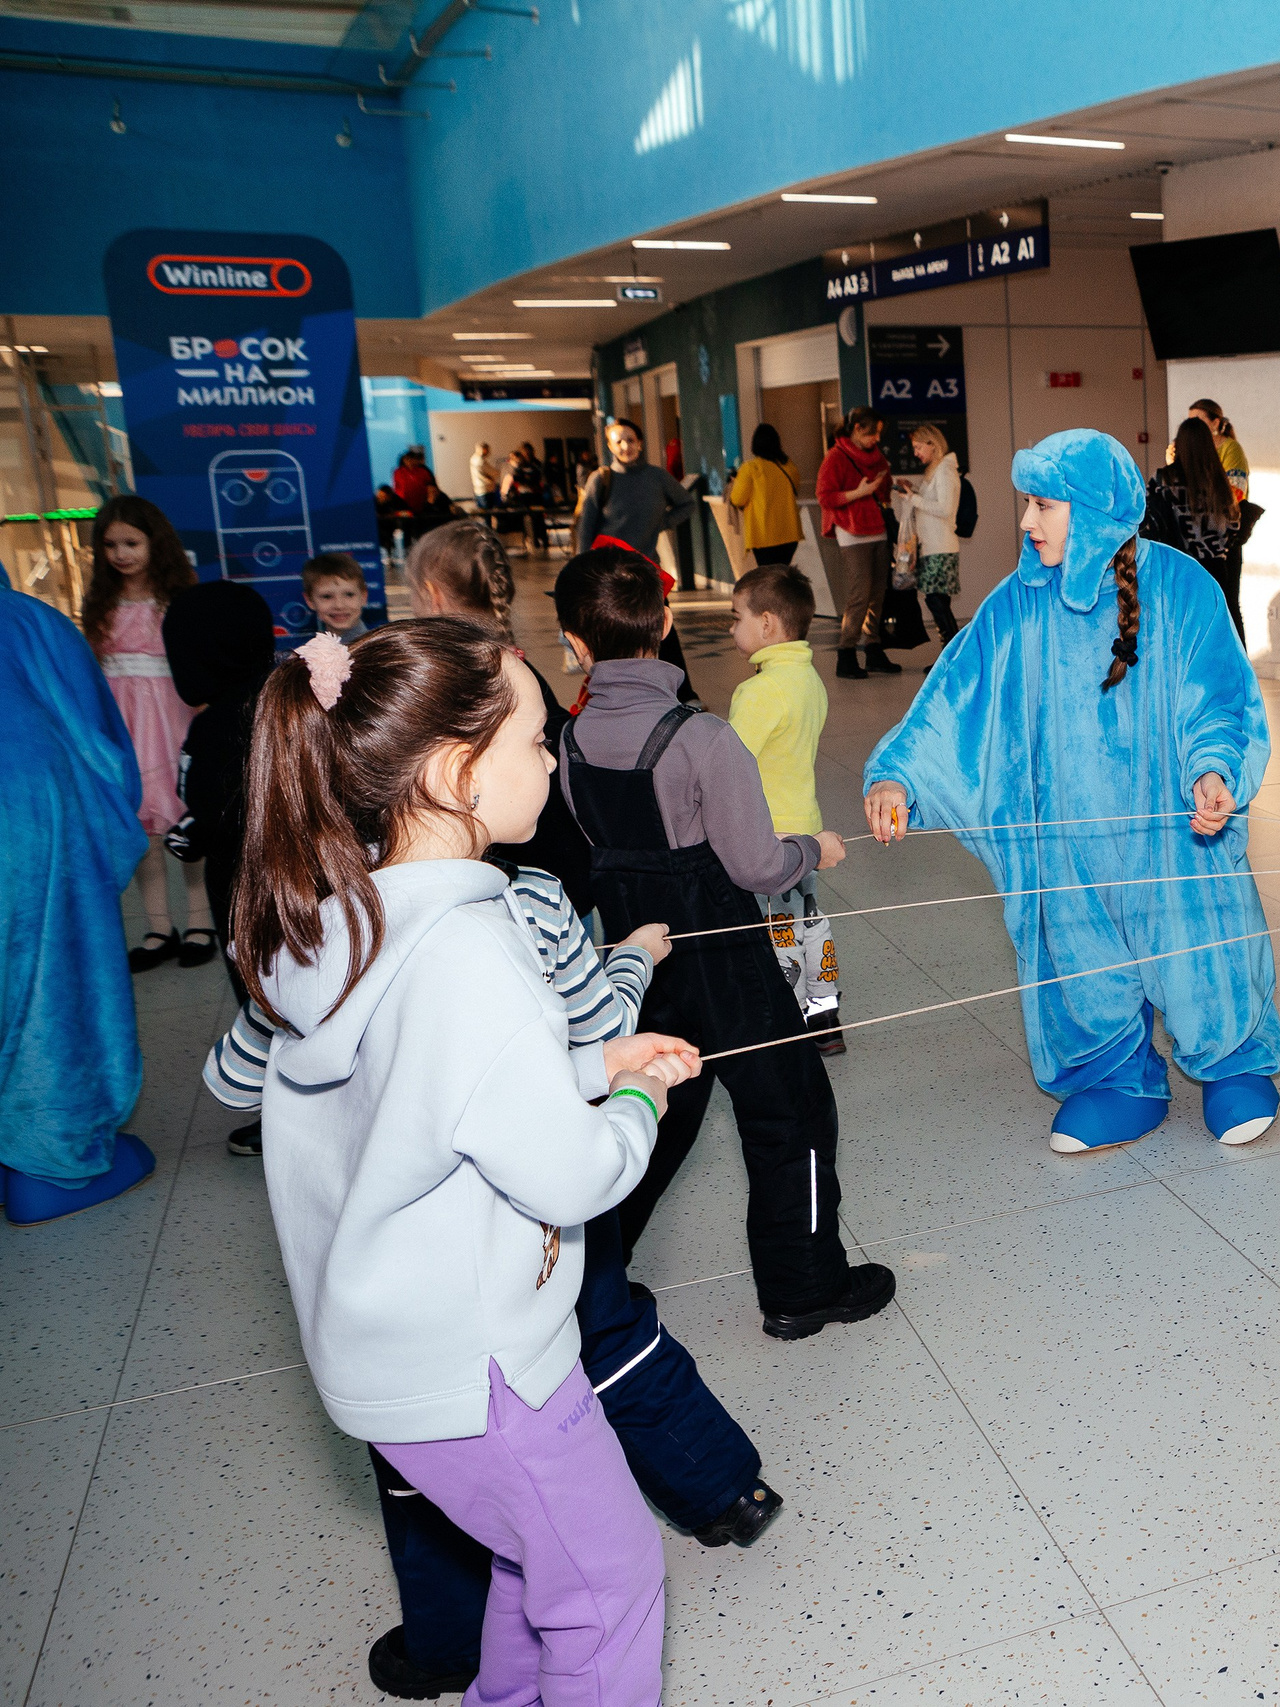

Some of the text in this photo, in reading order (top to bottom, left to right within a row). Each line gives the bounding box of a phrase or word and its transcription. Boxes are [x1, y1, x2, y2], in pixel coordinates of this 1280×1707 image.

[161, 263, 268, 288] Winline
[915, 264, 926, 276] НА
[224, 363, 268, 384] НА
[177, 386, 315, 406] МИЛЛИОН
